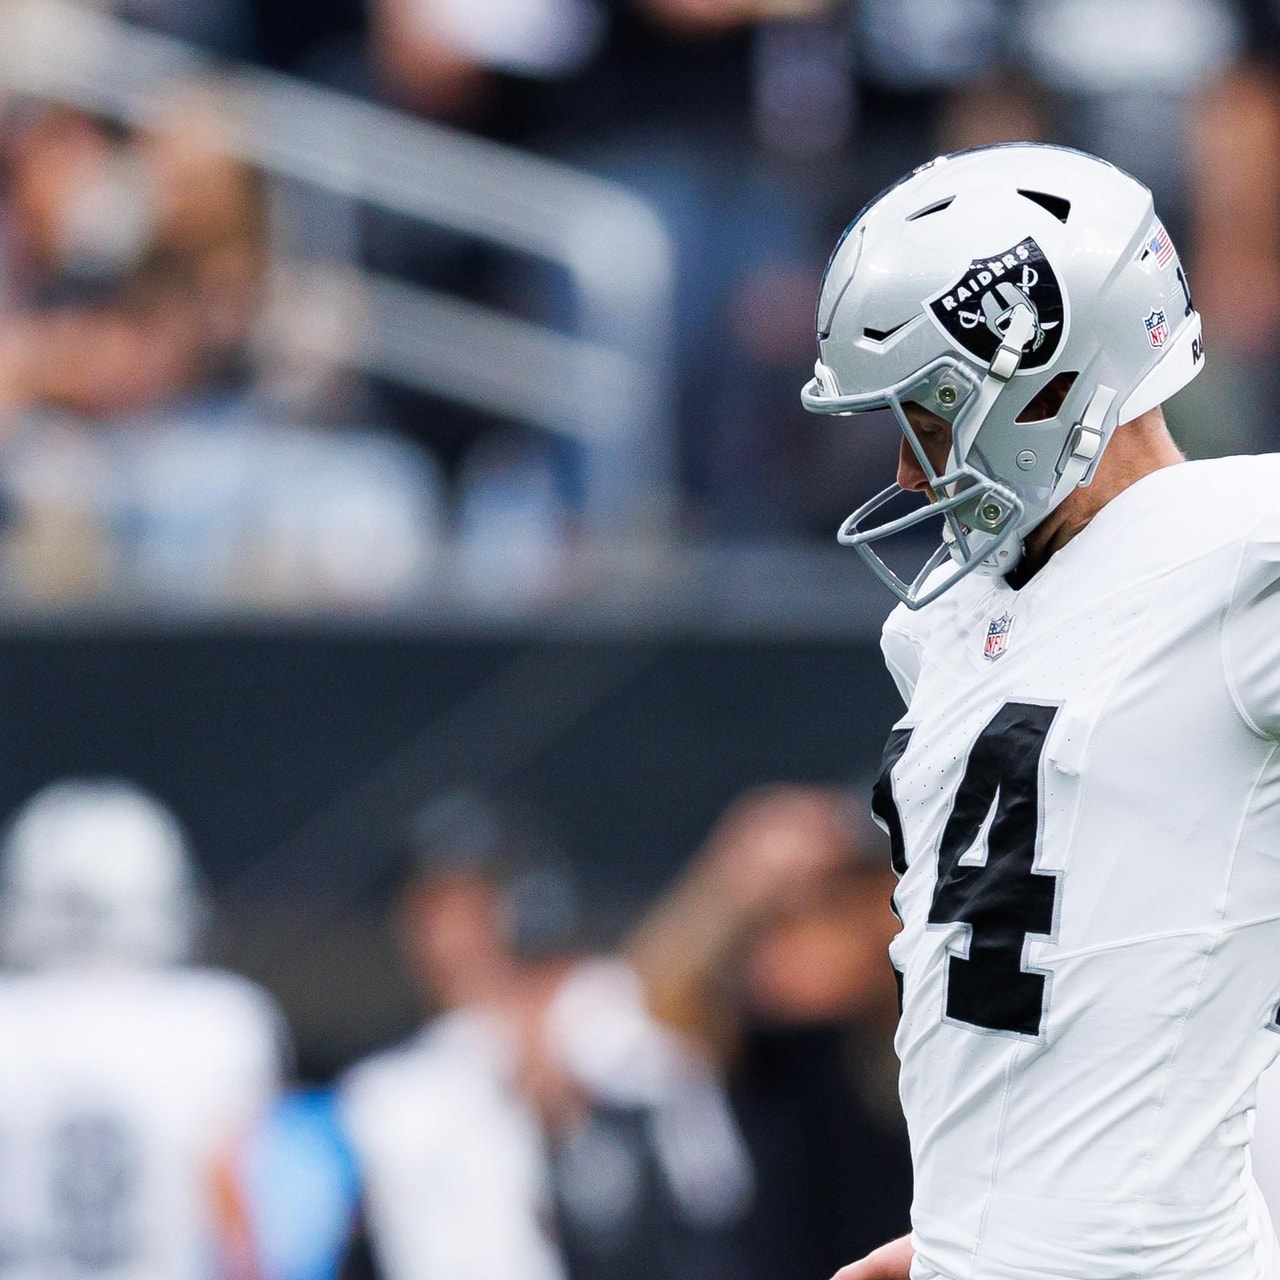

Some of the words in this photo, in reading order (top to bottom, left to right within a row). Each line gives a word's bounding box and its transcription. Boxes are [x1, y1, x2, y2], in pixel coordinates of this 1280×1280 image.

[941, 245, 1030, 311] RAIDERS
[1150, 324, 1168, 345] NFL
[986, 634, 1005, 655] NFL
